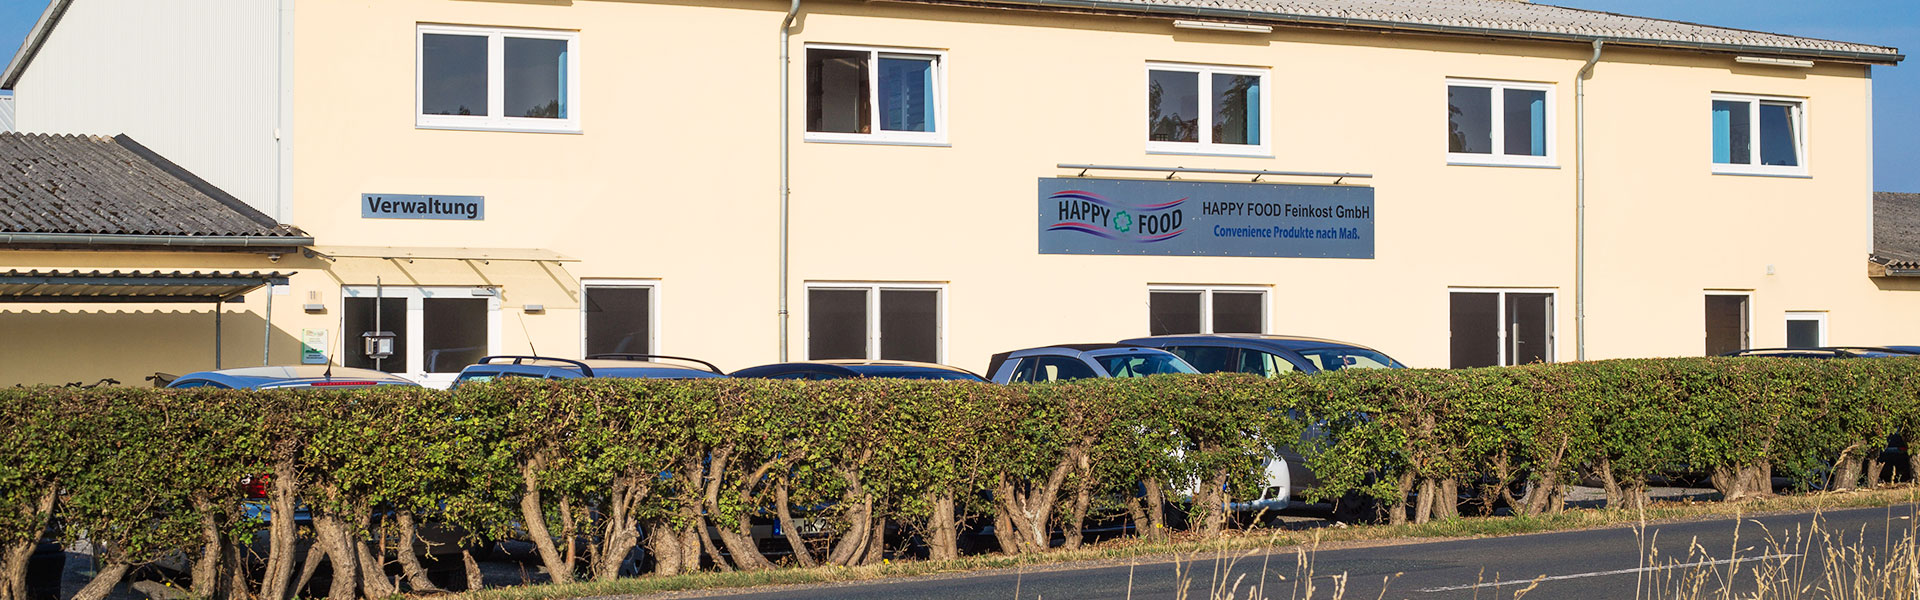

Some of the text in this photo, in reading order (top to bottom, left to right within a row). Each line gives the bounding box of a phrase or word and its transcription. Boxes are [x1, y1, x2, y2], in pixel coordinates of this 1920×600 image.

[367, 196, 478, 219] Verwaltung
[1058, 199, 1183, 235] HAPPY FOOD
[1202, 201, 1370, 219] HAPPY FOOD Feinkost GmbH
[1213, 224, 1360, 240] Convenience Produkte nach Maß.
